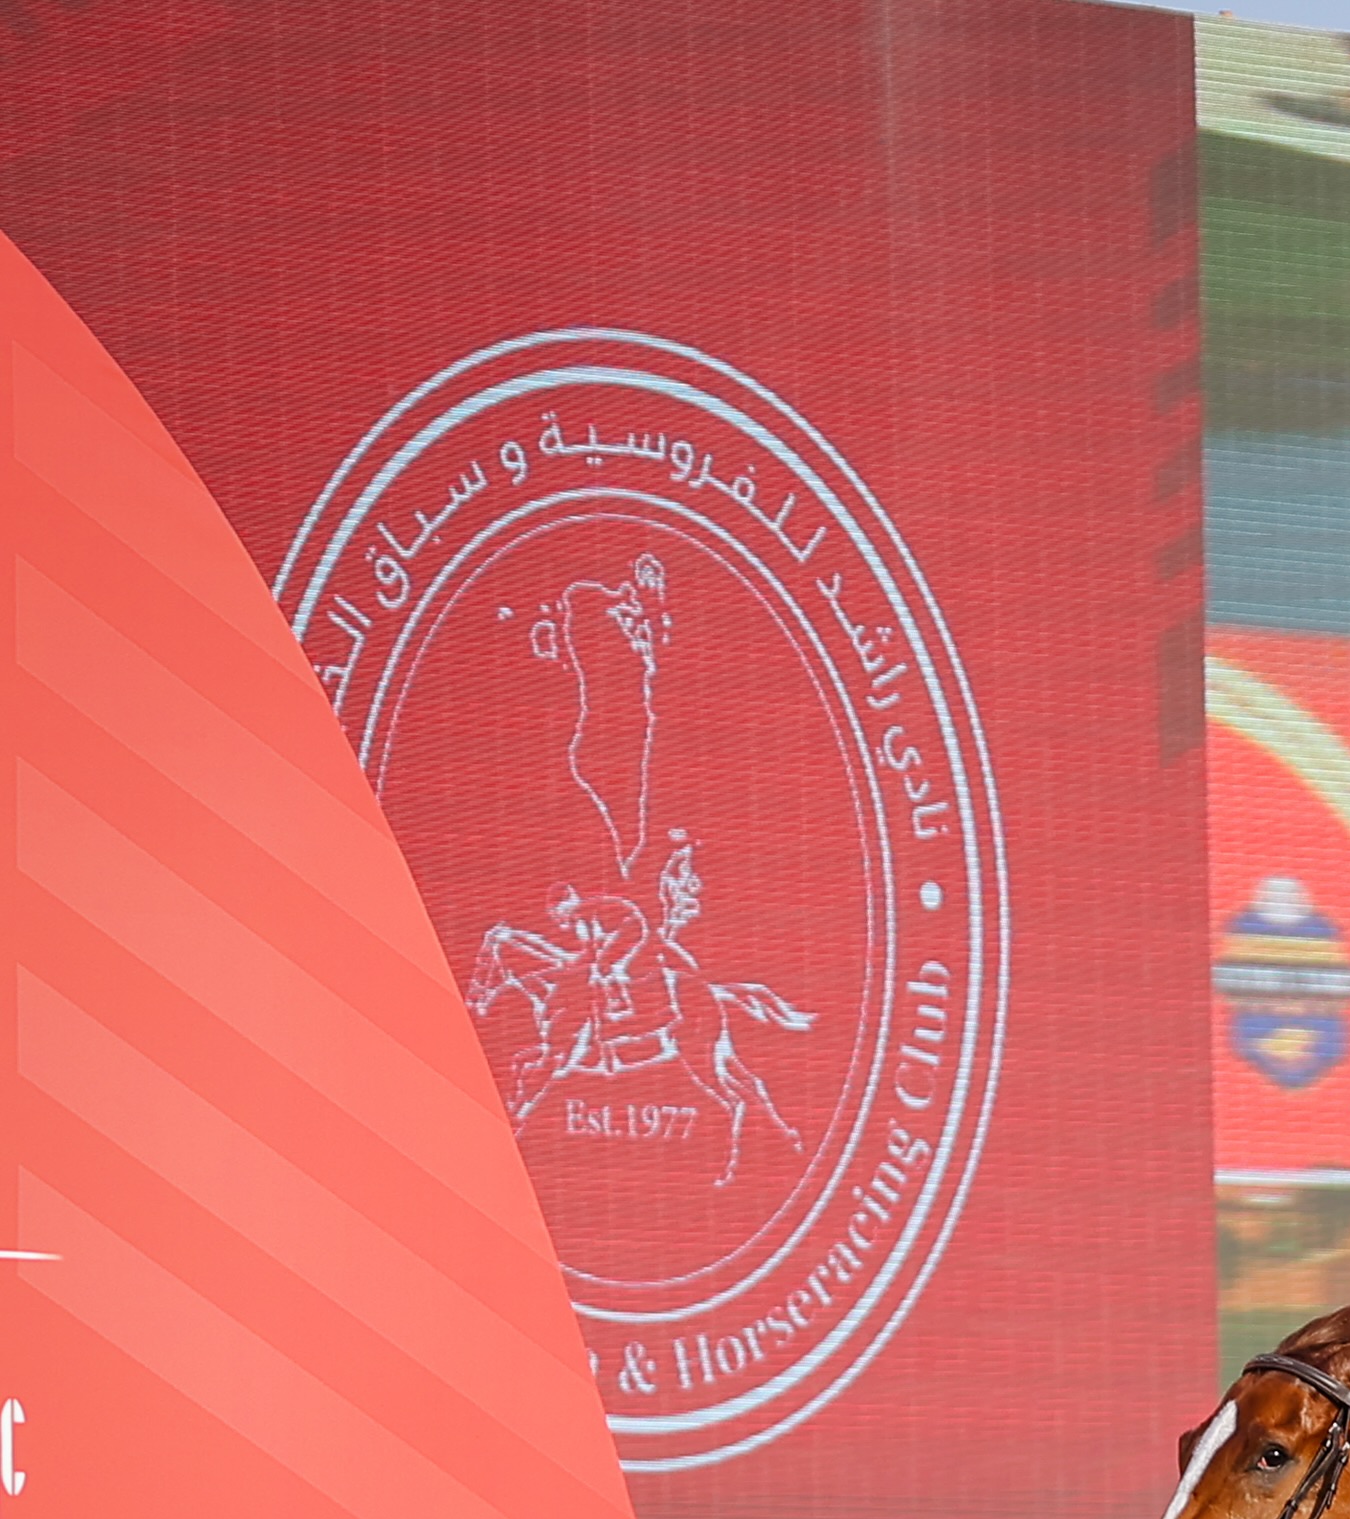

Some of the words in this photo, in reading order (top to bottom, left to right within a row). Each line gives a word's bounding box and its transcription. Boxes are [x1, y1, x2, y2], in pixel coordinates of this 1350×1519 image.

[365, 460, 490, 611] سباق
[538, 410, 828, 563] للفروسية
[313, 593, 374, 732] الخ
[815, 572, 909, 710] راشد
[876, 724, 950, 839] نادي
[564, 1098, 699, 1141] Est.1977
[616, 1340, 657, 1395] &
[671, 1116, 933, 1392] Horseracing
[893, 959, 952, 1111] Club
